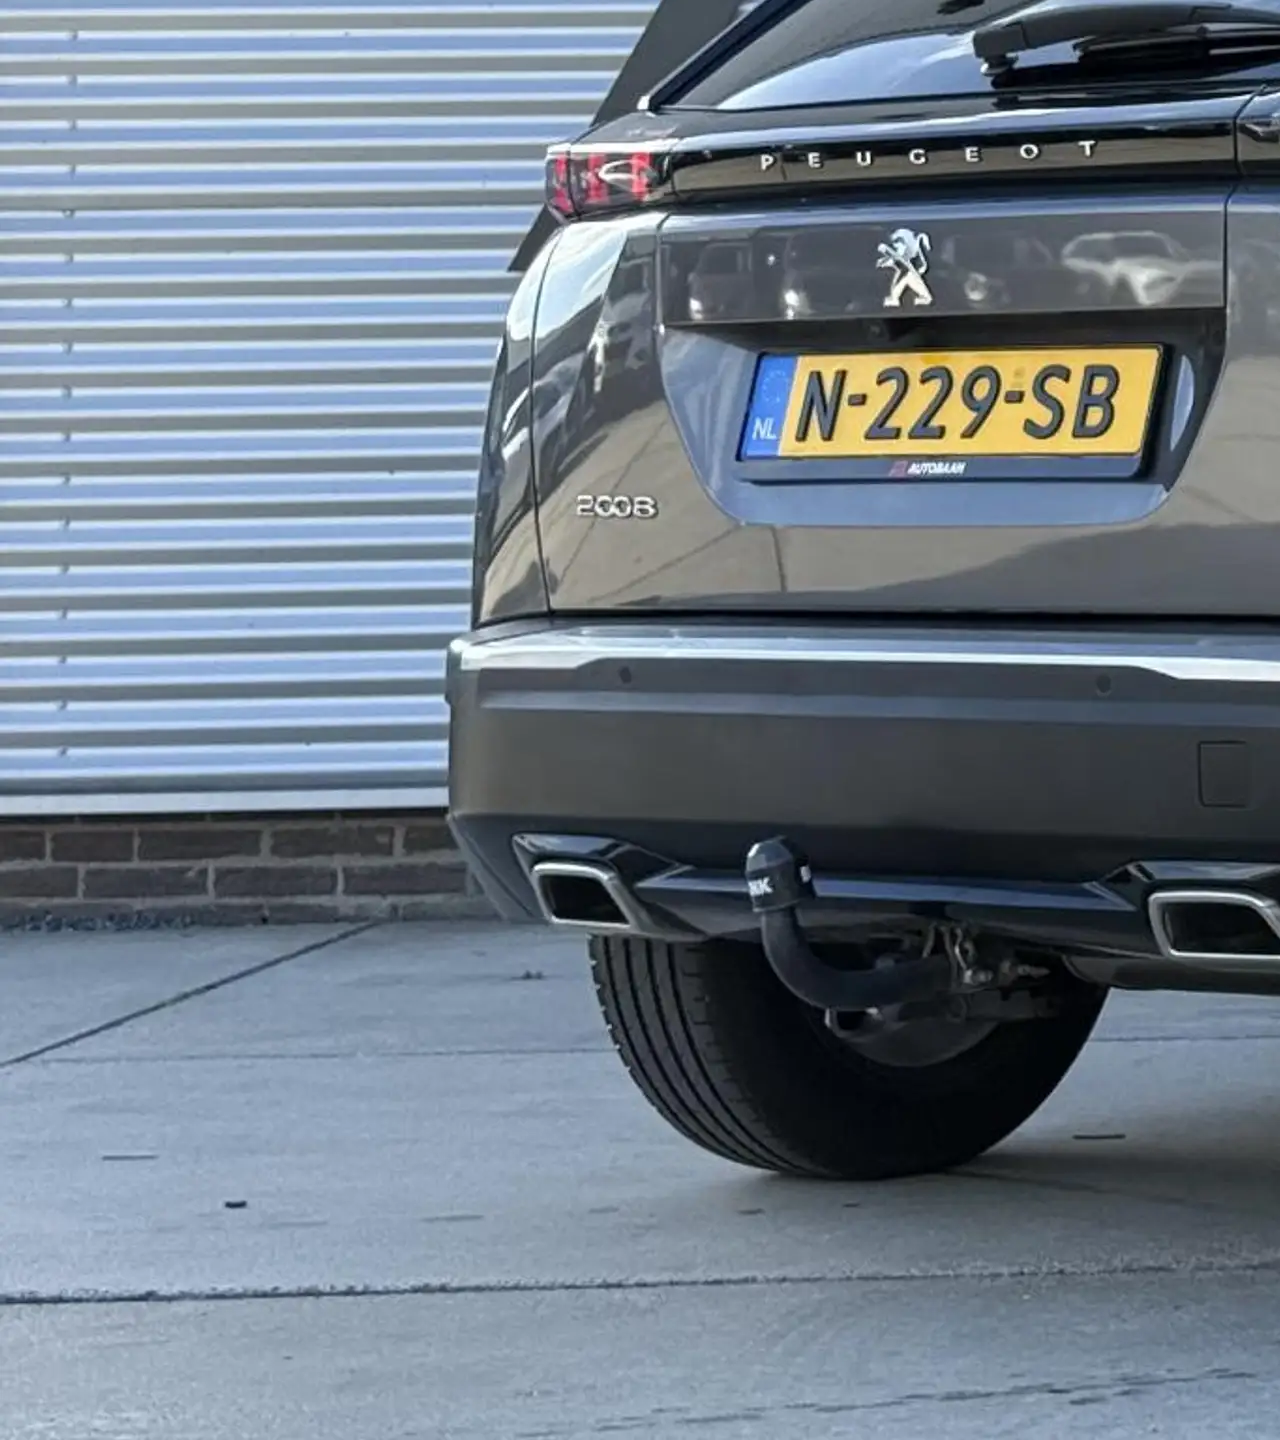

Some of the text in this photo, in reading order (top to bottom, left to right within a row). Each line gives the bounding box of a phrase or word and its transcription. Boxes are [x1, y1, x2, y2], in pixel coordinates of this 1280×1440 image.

[760, 139, 1097, 172] PEUGEOT
[794, 363, 1121, 443] N-229-SB
[751, 416, 777, 441] NL
[576, 494, 658, 518] 2008
